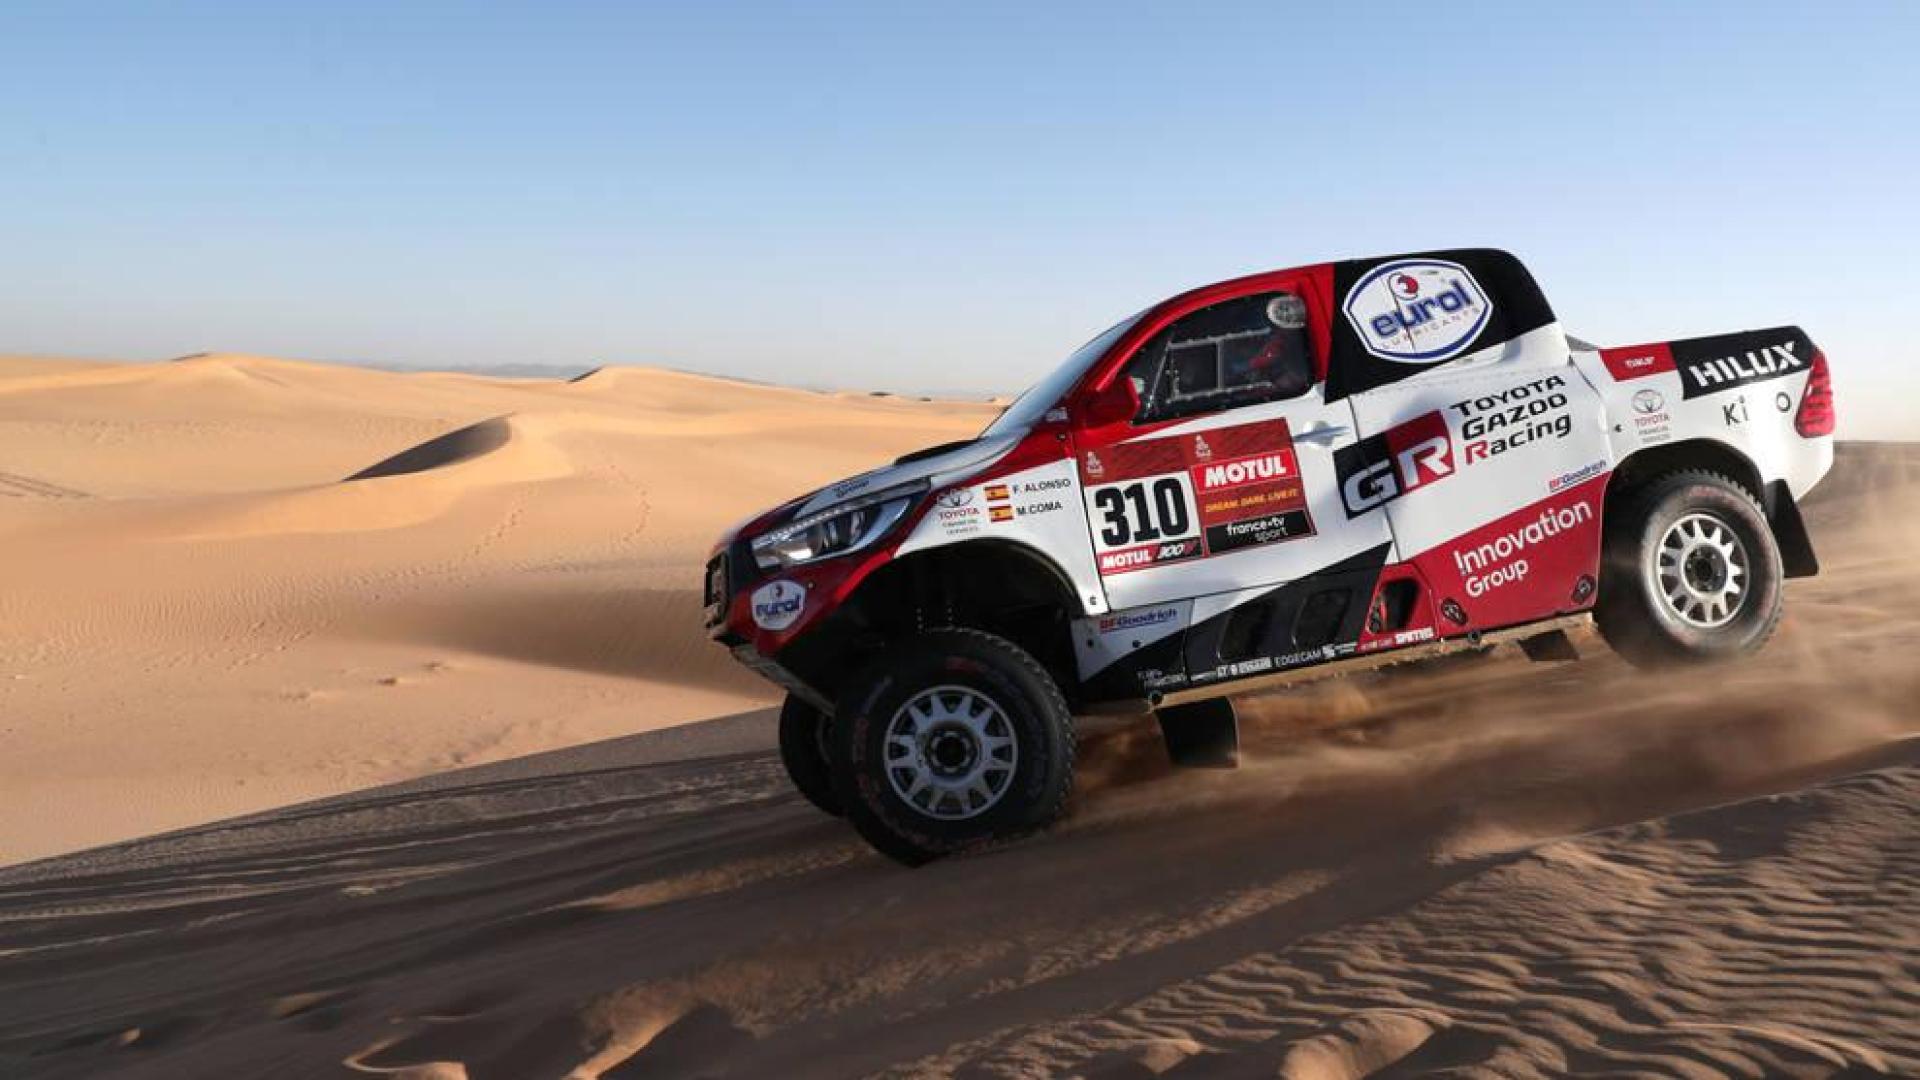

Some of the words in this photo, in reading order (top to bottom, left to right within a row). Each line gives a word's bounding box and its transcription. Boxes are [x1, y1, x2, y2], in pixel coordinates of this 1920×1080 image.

[1370, 279, 1473, 337] eurol
[1689, 340, 1803, 387] HILUX
[1450, 375, 1566, 417] TOYOTA
[1461, 393, 1568, 441] GAZOO
[1465, 414, 1571, 466] Racing
[1025, 479, 1071, 492] ALONSO
[1205, 455, 1287, 488] MOTUL
[1345, 436, 1452, 513] GR
[1095, 477, 1190, 546] 310
[1102, 549, 1152, 569] MOTUL
[1454, 501, 1593, 574] Innovation
[1466, 559, 1529, 597] Group
